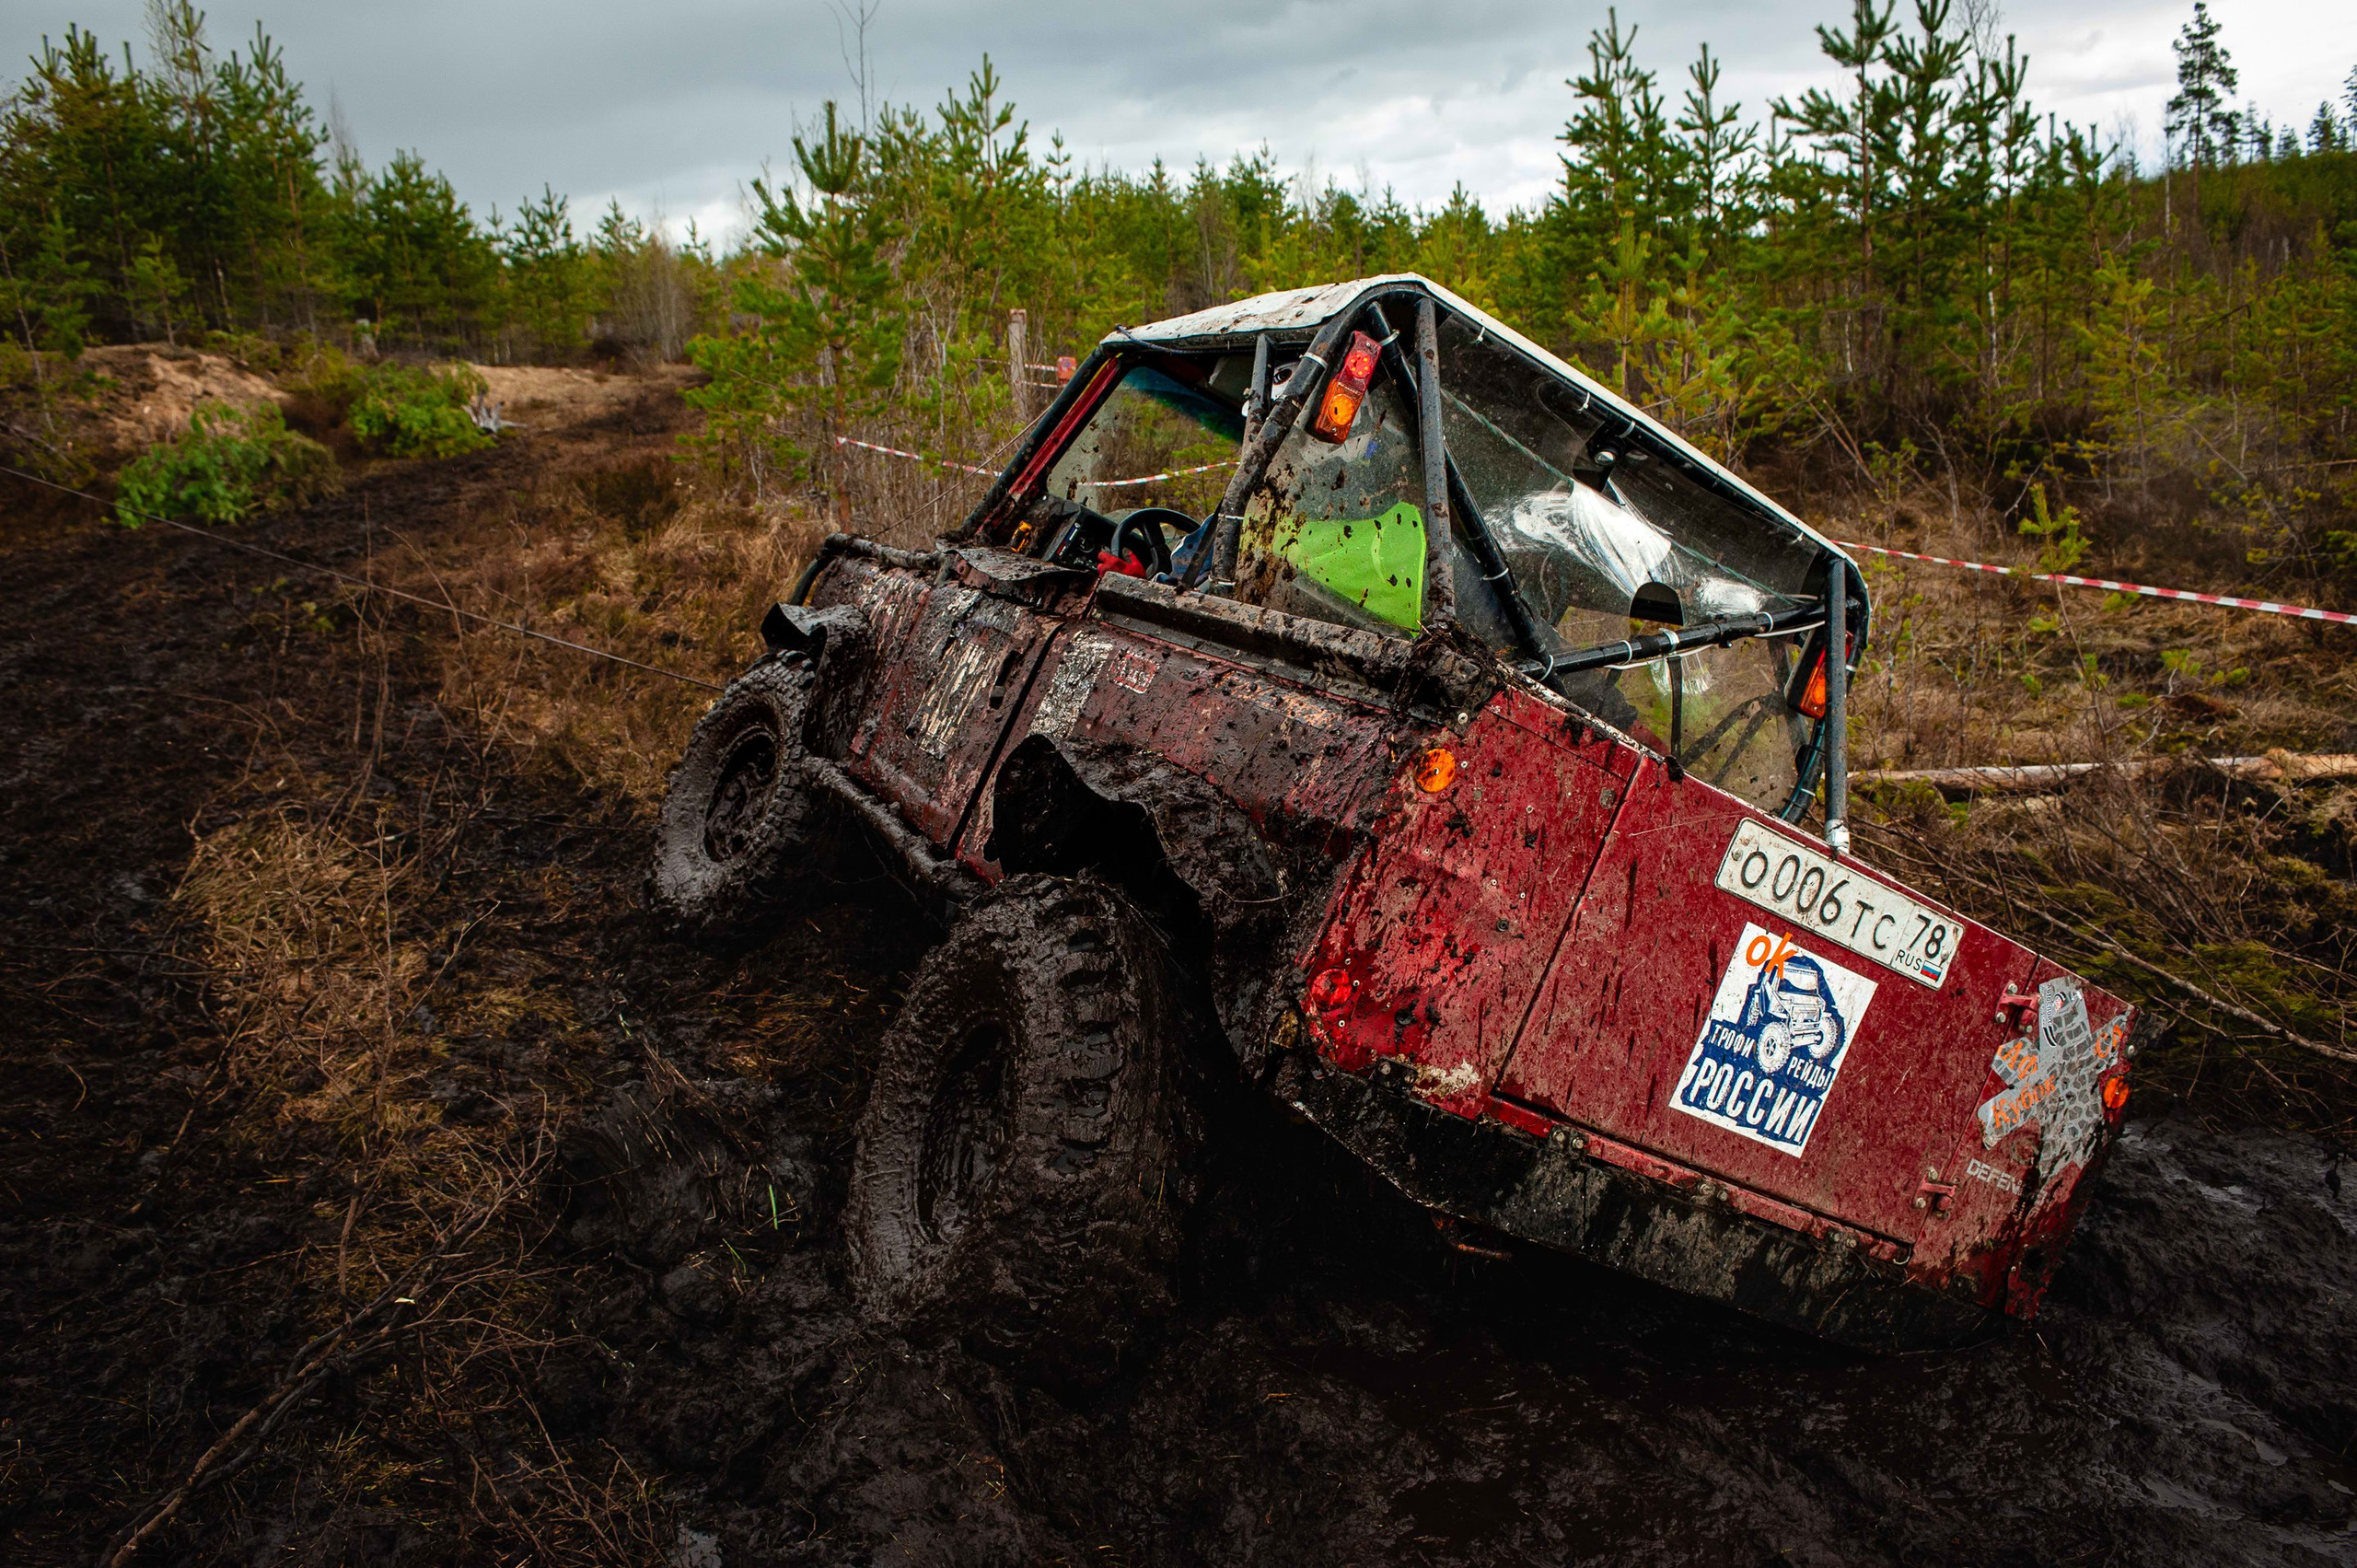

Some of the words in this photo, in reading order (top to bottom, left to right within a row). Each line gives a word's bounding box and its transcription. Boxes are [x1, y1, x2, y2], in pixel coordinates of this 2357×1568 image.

[1895, 948, 1922, 971] RUS
[1909, 913, 1946, 959] 78
[1710, 1024, 1757, 1058] ТРОФИ
[1786, 1056, 1831, 1089] РЕЙДЫ
[1689, 1057, 1819, 1144] РОССИИ
[1991, 1074, 2057, 1129] Кубок
